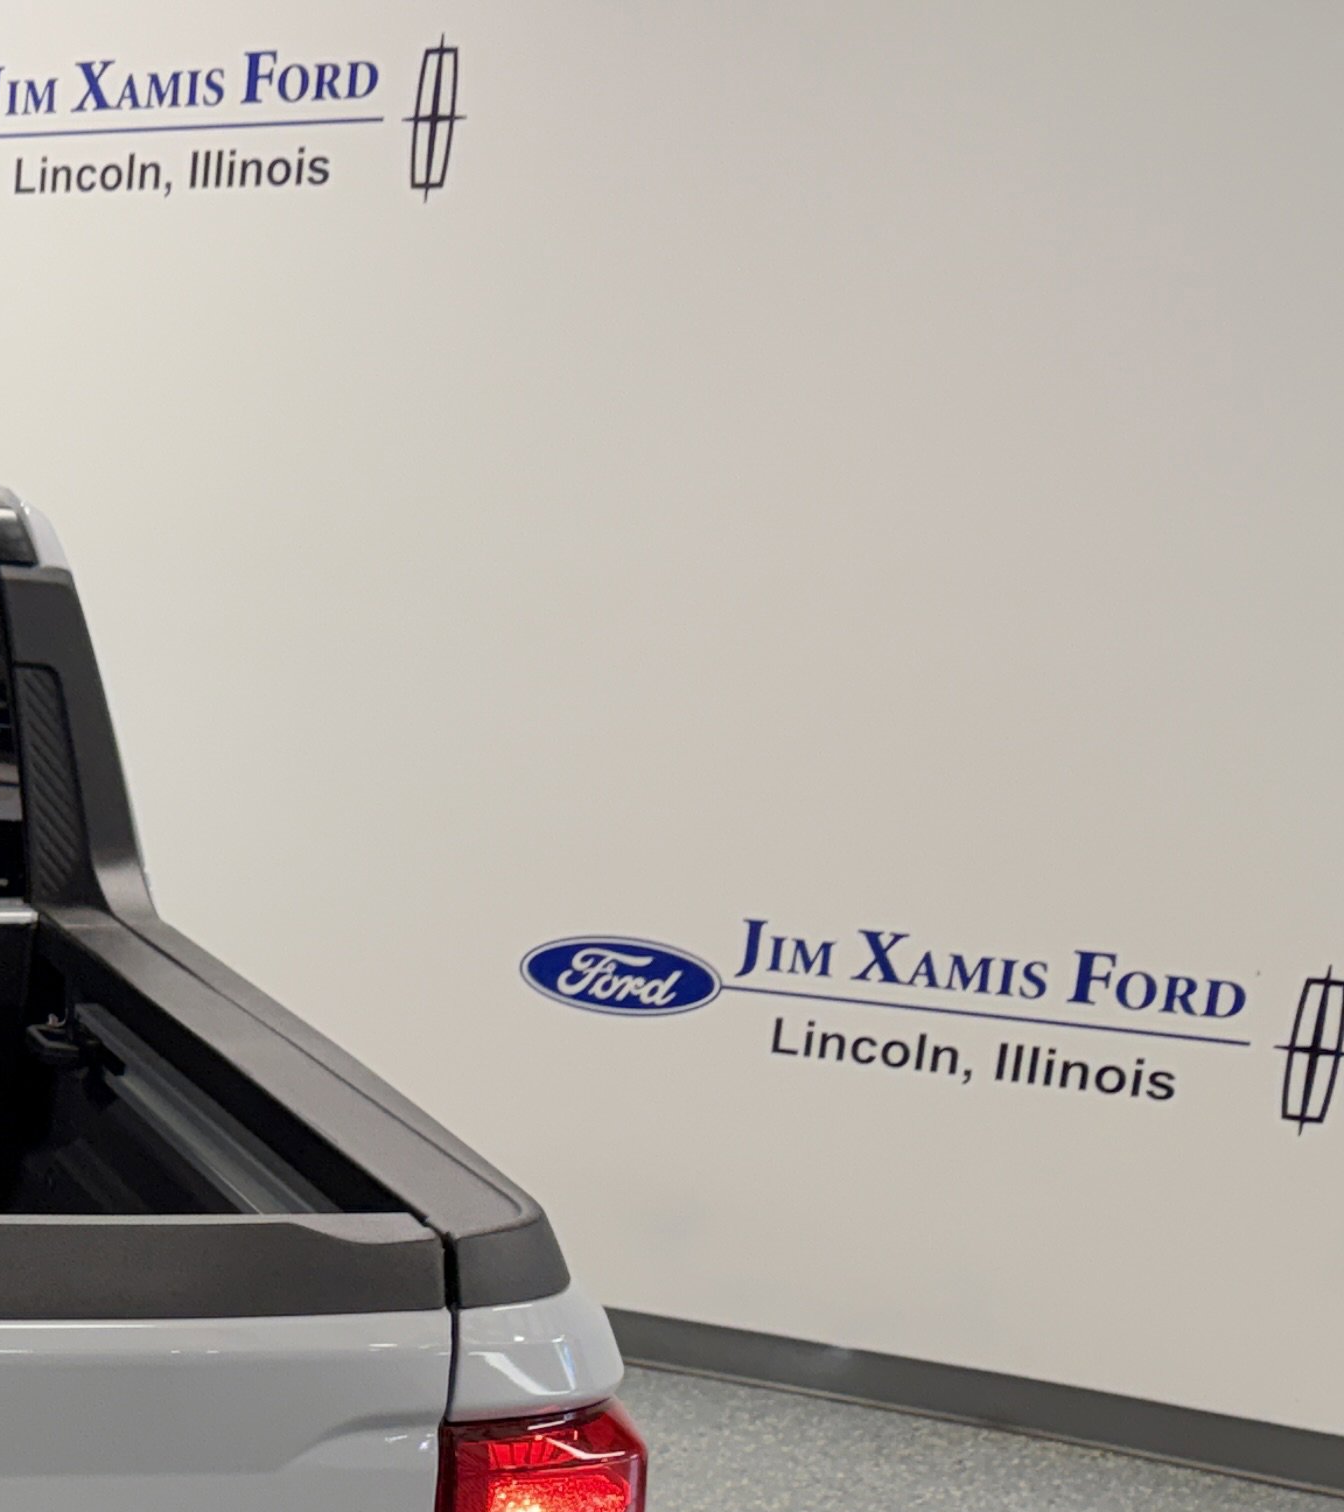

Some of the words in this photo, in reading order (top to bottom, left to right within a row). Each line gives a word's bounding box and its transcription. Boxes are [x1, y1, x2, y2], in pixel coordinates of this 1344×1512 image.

[71, 59, 225, 113] XAMIS
[240, 49, 379, 105] FORD
[13, 152, 173, 198] Lincoln,
[188, 147, 331, 188] Illinois
[556, 946, 677, 1007] Ford
[735, 918, 838, 979] JIM
[850, 929, 1048, 1000] XAMIS
[1066, 949, 1248, 1021] FORD
[770, 1018, 974, 1085] Lincoln,
[993, 1043, 1178, 1103] Illinois
